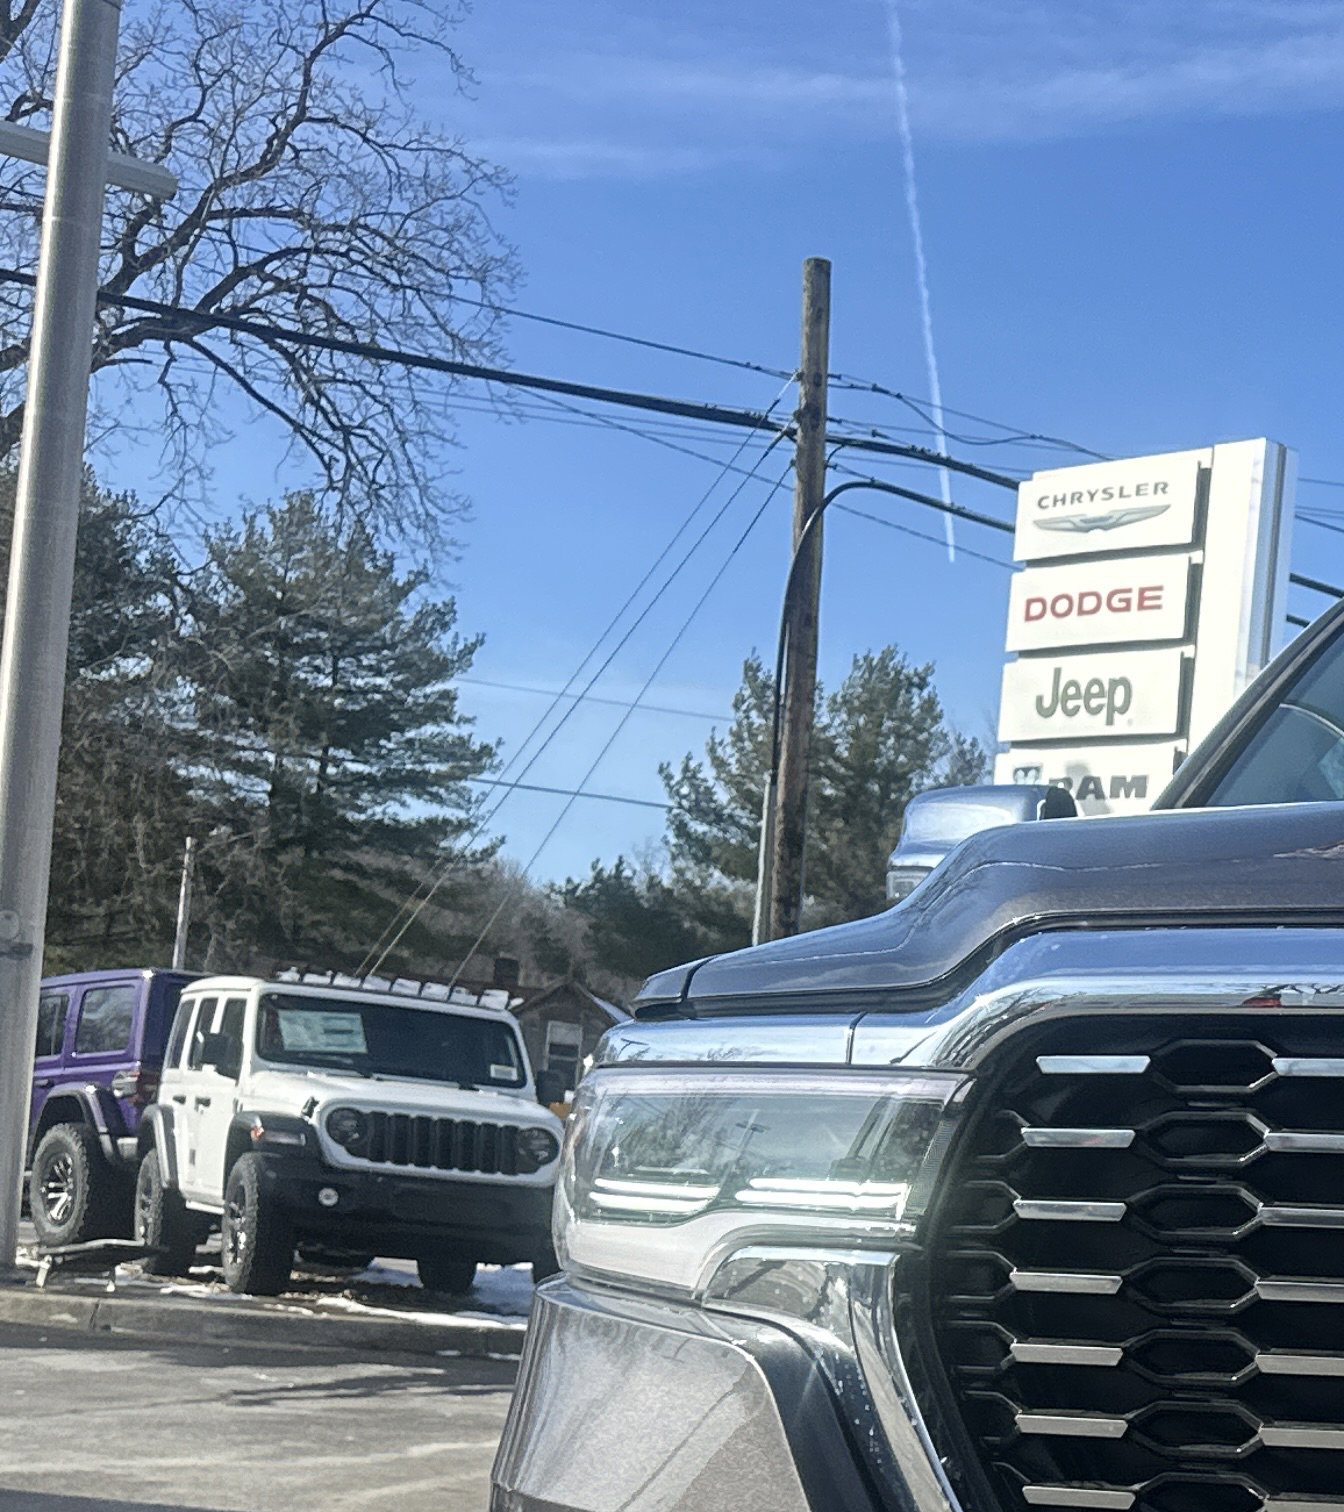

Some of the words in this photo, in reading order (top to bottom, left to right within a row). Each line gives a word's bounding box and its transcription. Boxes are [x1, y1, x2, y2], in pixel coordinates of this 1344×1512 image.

[1037, 481, 1169, 510] CHRYSLER
[1024, 585, 1164, 622] DODGE
[1035, 667, 1133, 727] Jeep
